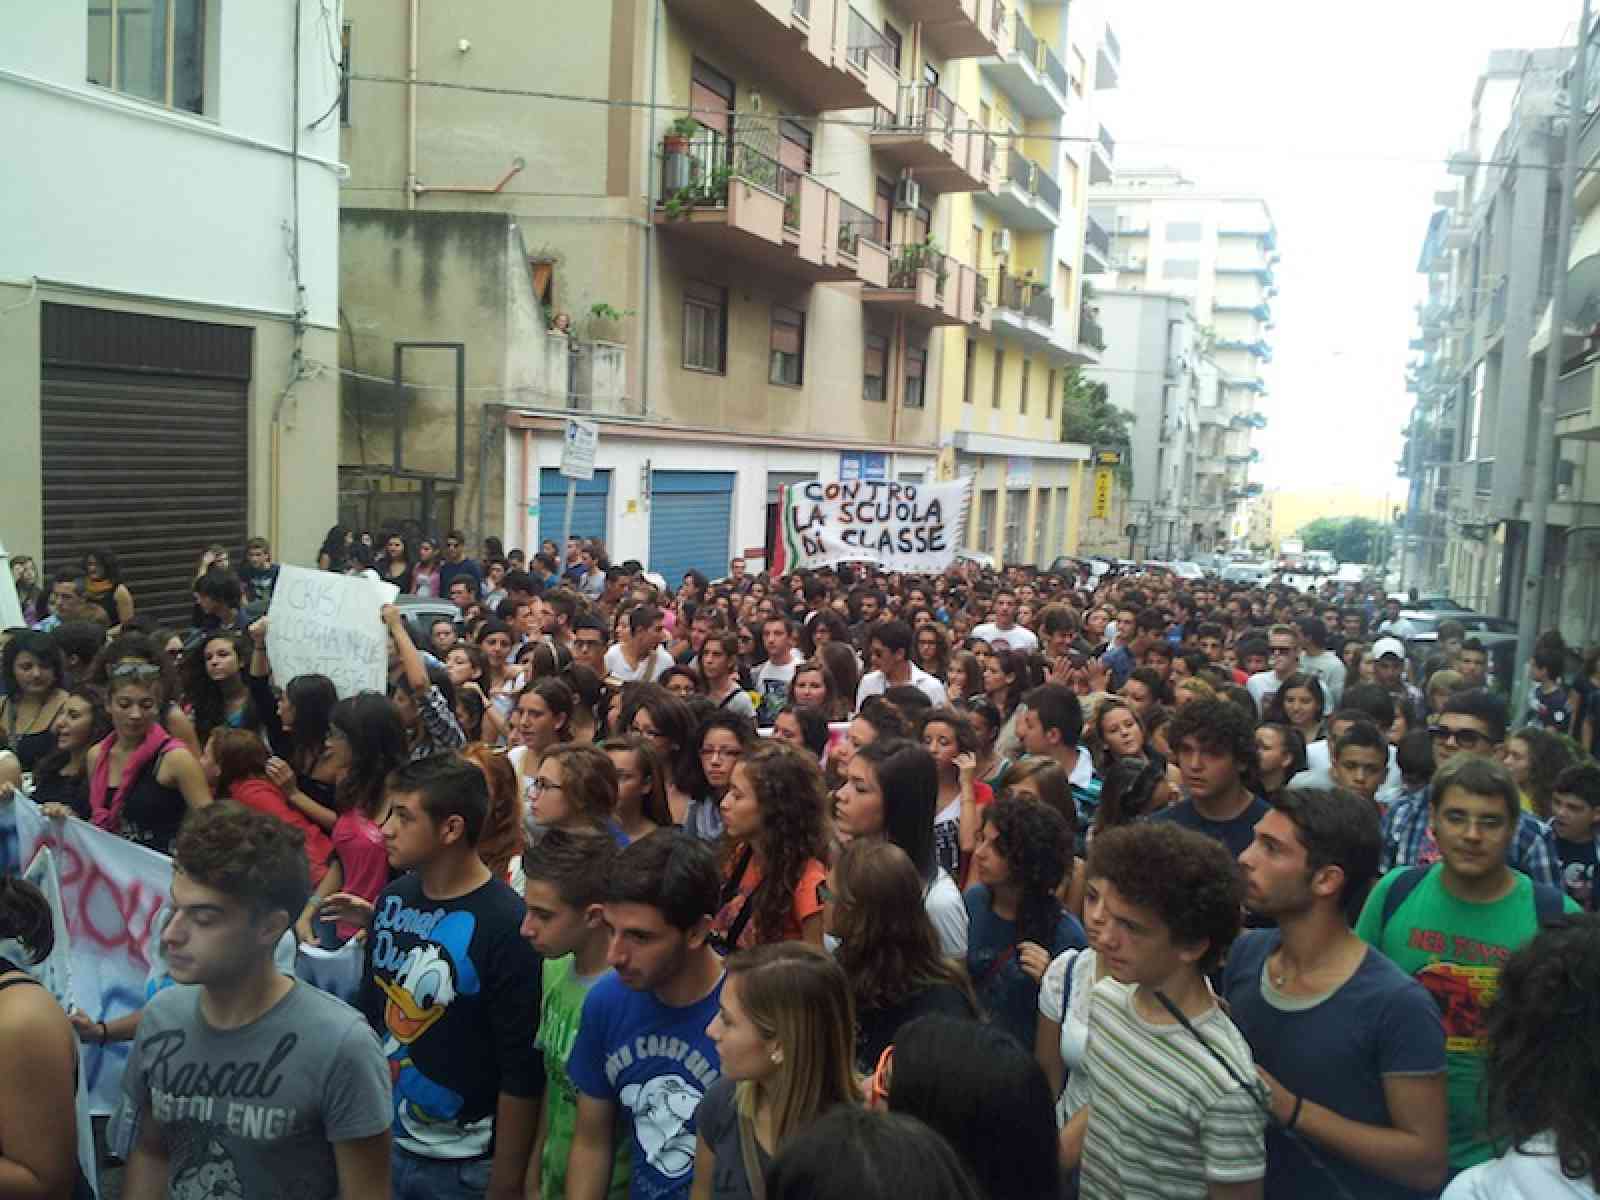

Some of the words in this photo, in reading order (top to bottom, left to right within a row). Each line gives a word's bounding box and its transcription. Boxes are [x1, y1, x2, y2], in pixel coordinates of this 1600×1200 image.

[805, 480, 916, 502] CONTRO
[793, 504, 826, 532] LA
[838, 498, 941, 524] SCUOLA
[841, 525, 946, 555] CLASSE
[142, 1029, 298, 1098] Rascal
